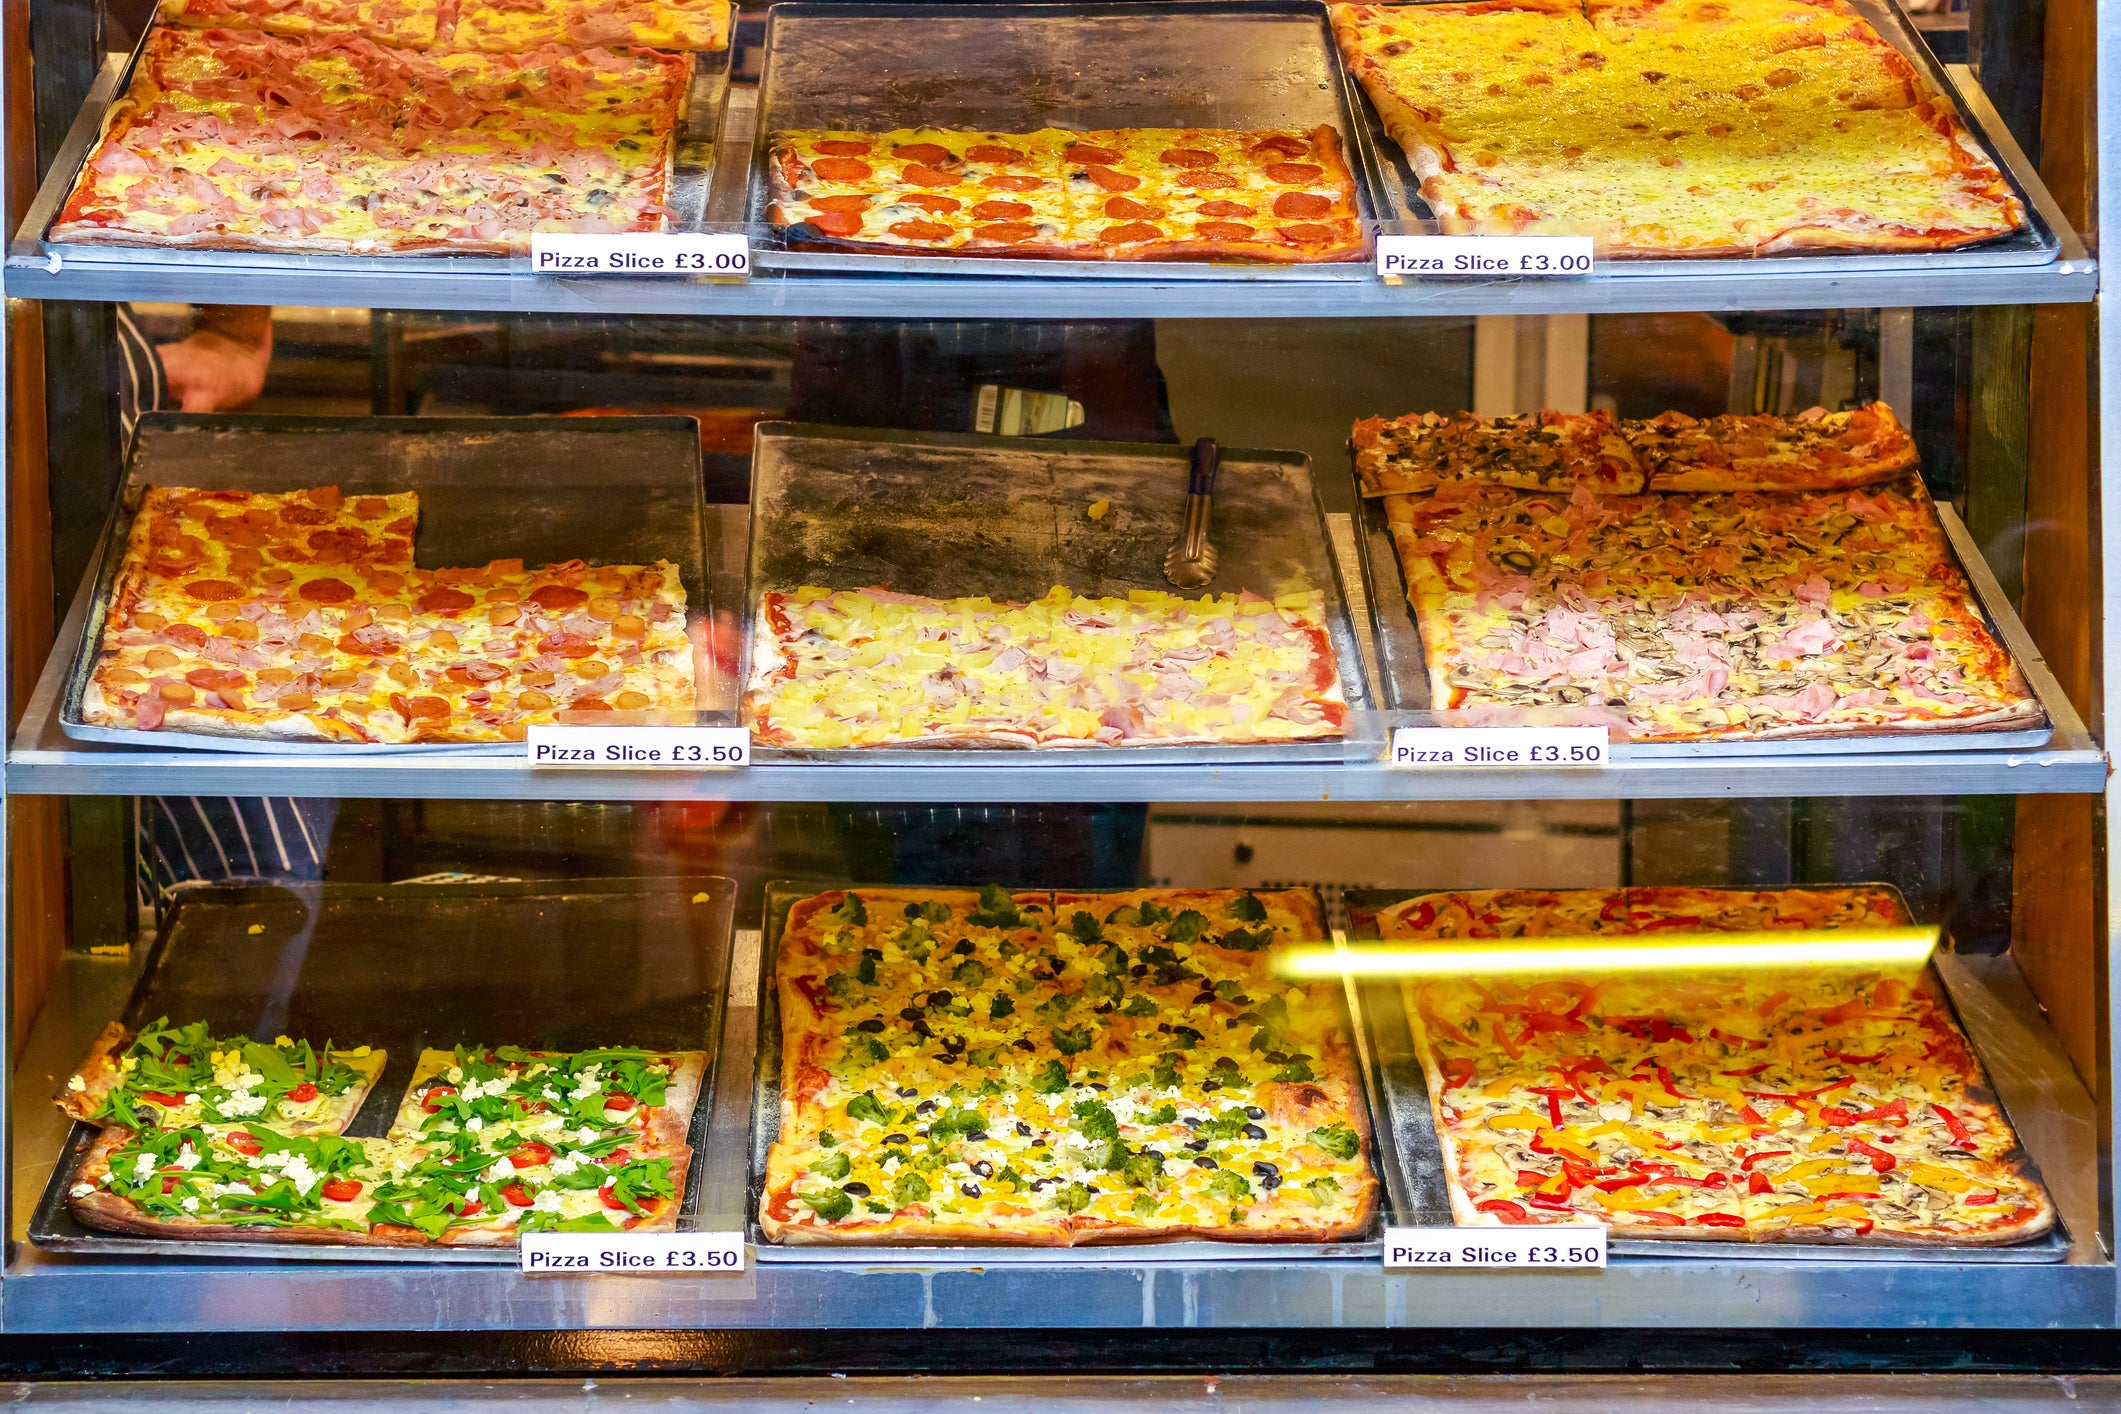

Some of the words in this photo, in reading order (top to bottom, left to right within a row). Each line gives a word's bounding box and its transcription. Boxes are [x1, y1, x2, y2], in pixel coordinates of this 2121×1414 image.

[540, 252, 599, 268] Pizza
[609, 252, 665, 269] Slice
[675, 253, 746, 270] £3.00
[1386, 254, 1444, 270] Pizza
[1454, 254, 1509, 270] Slice
[1520, 255, 1590, 271] £3.00
[537, 744, 595, 761] Pizza
[605, 745, 661, 761] Slice
[672, 745, 743, 762] £3.50
[1397, 747, 1453, 762] Pizza
[1464, 746, 1519, 762] Slice
[1530, 745, 1600, 762] £3.50
[530, 1251, 589, 1267] Pizza
[599, 1251, 655, 1267] Slice
[666, 1250, 738, 1267] £3.50
[1393, 1247, 1451, 1263] Pizza
[1461, 1247, 1517, 1263] Slice
[1527, 1246, 1599, 1263] £3.50
